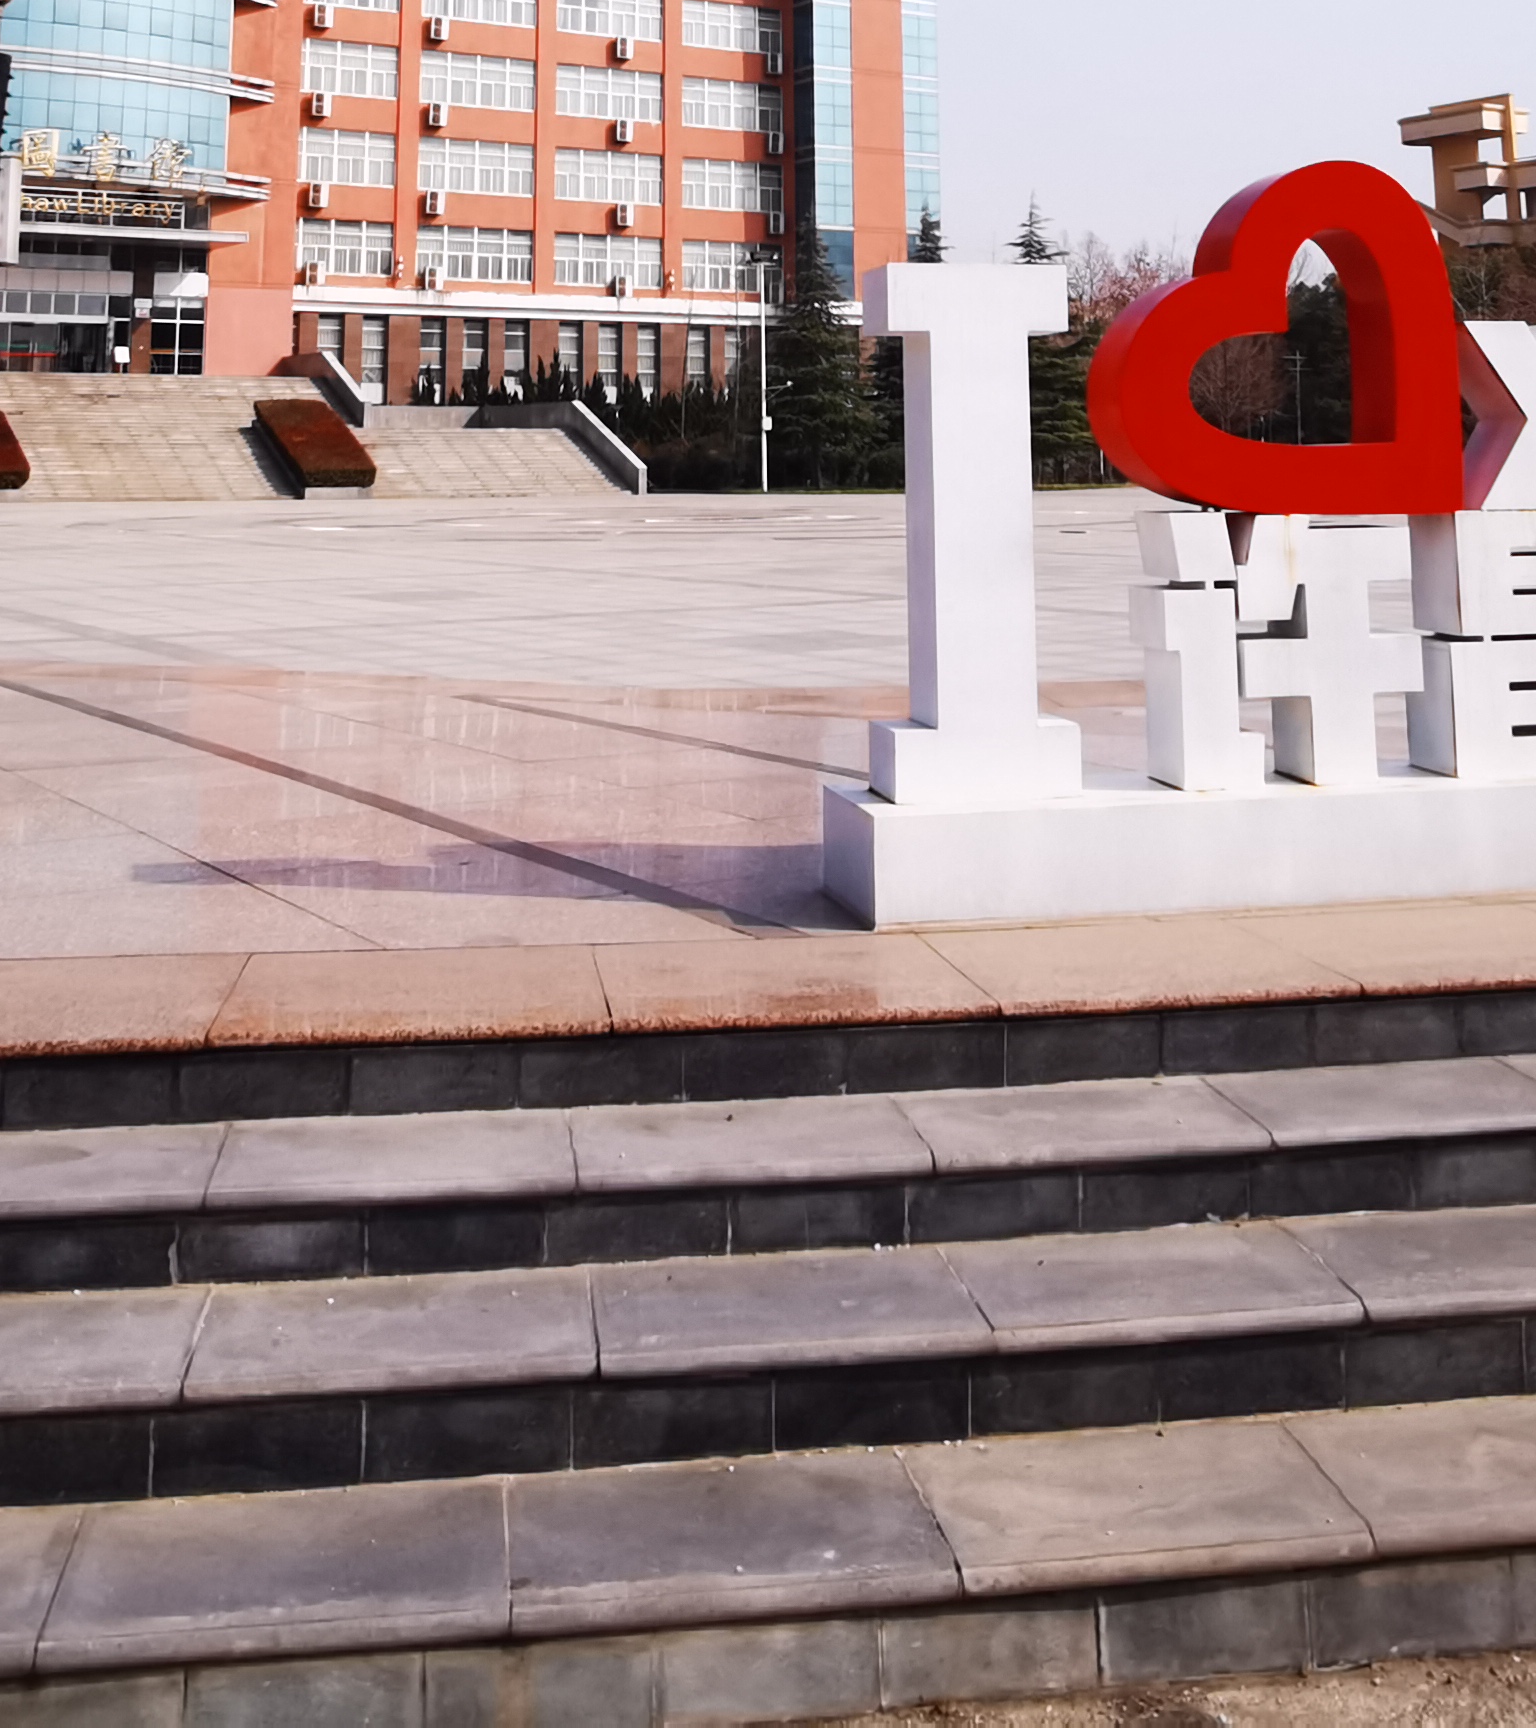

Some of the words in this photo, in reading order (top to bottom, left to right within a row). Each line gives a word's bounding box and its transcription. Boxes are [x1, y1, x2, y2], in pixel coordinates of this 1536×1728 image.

[22, 191, 71, 213] haw
[77, 189, 175, 224] Library
[866, 262, 1080, 804] I
